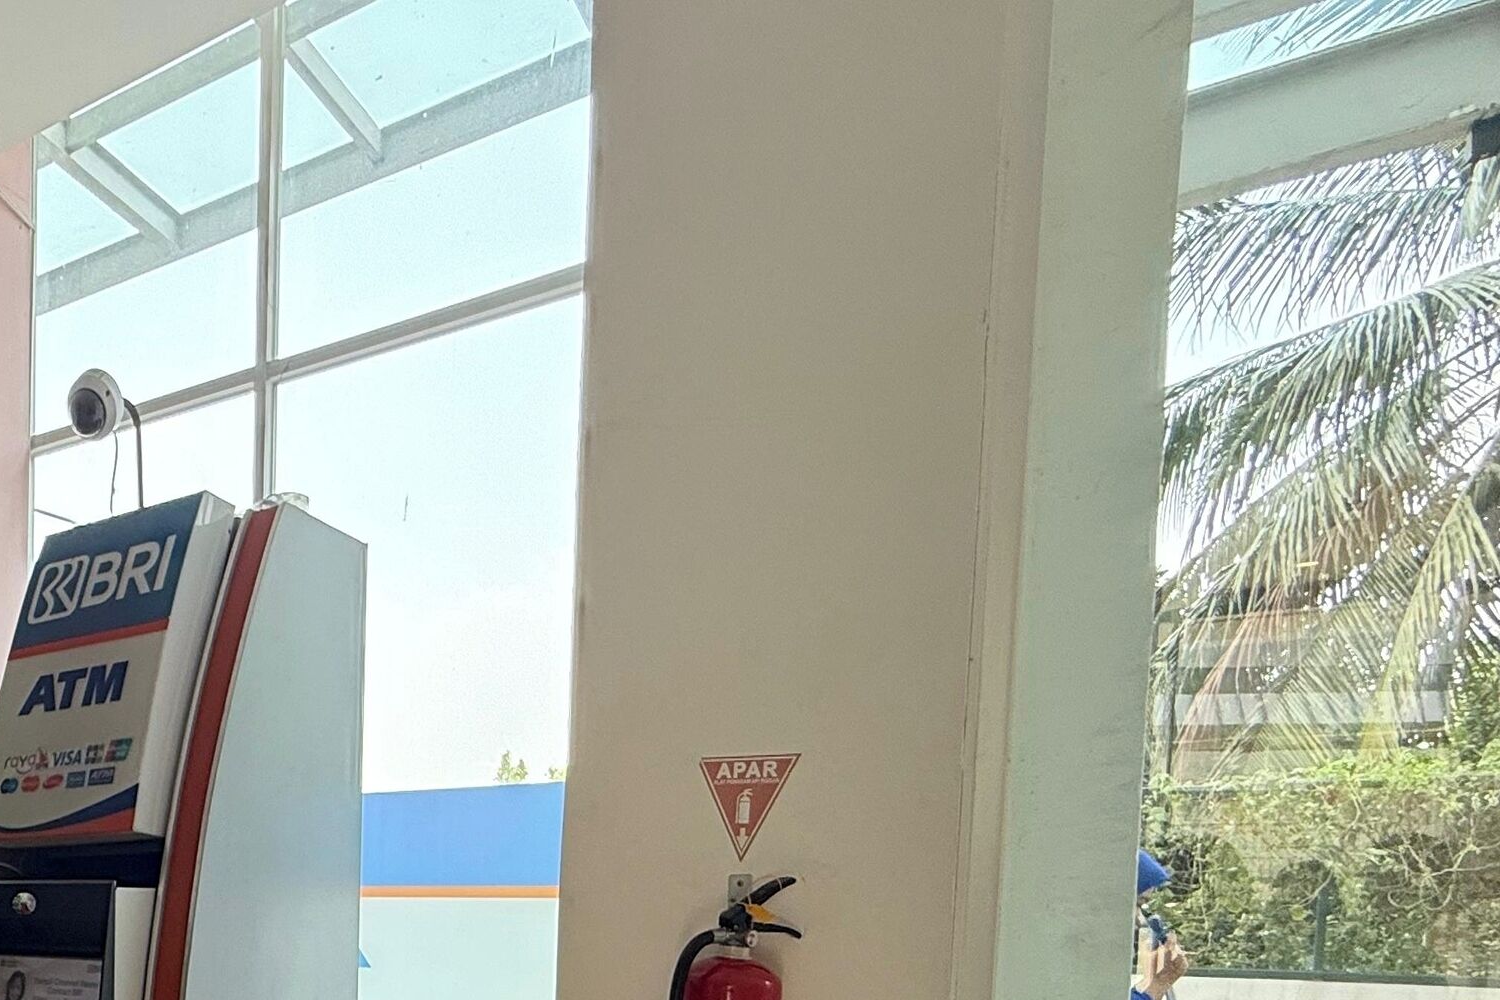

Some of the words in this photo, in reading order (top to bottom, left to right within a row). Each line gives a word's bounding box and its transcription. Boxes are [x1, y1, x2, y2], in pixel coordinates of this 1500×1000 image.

[80, 535, 176, 609] BRI
[18, 661, 129, 716] ATM
[52, 750, 81, 767] VISA
[716, 761, 778, 779] APAR
